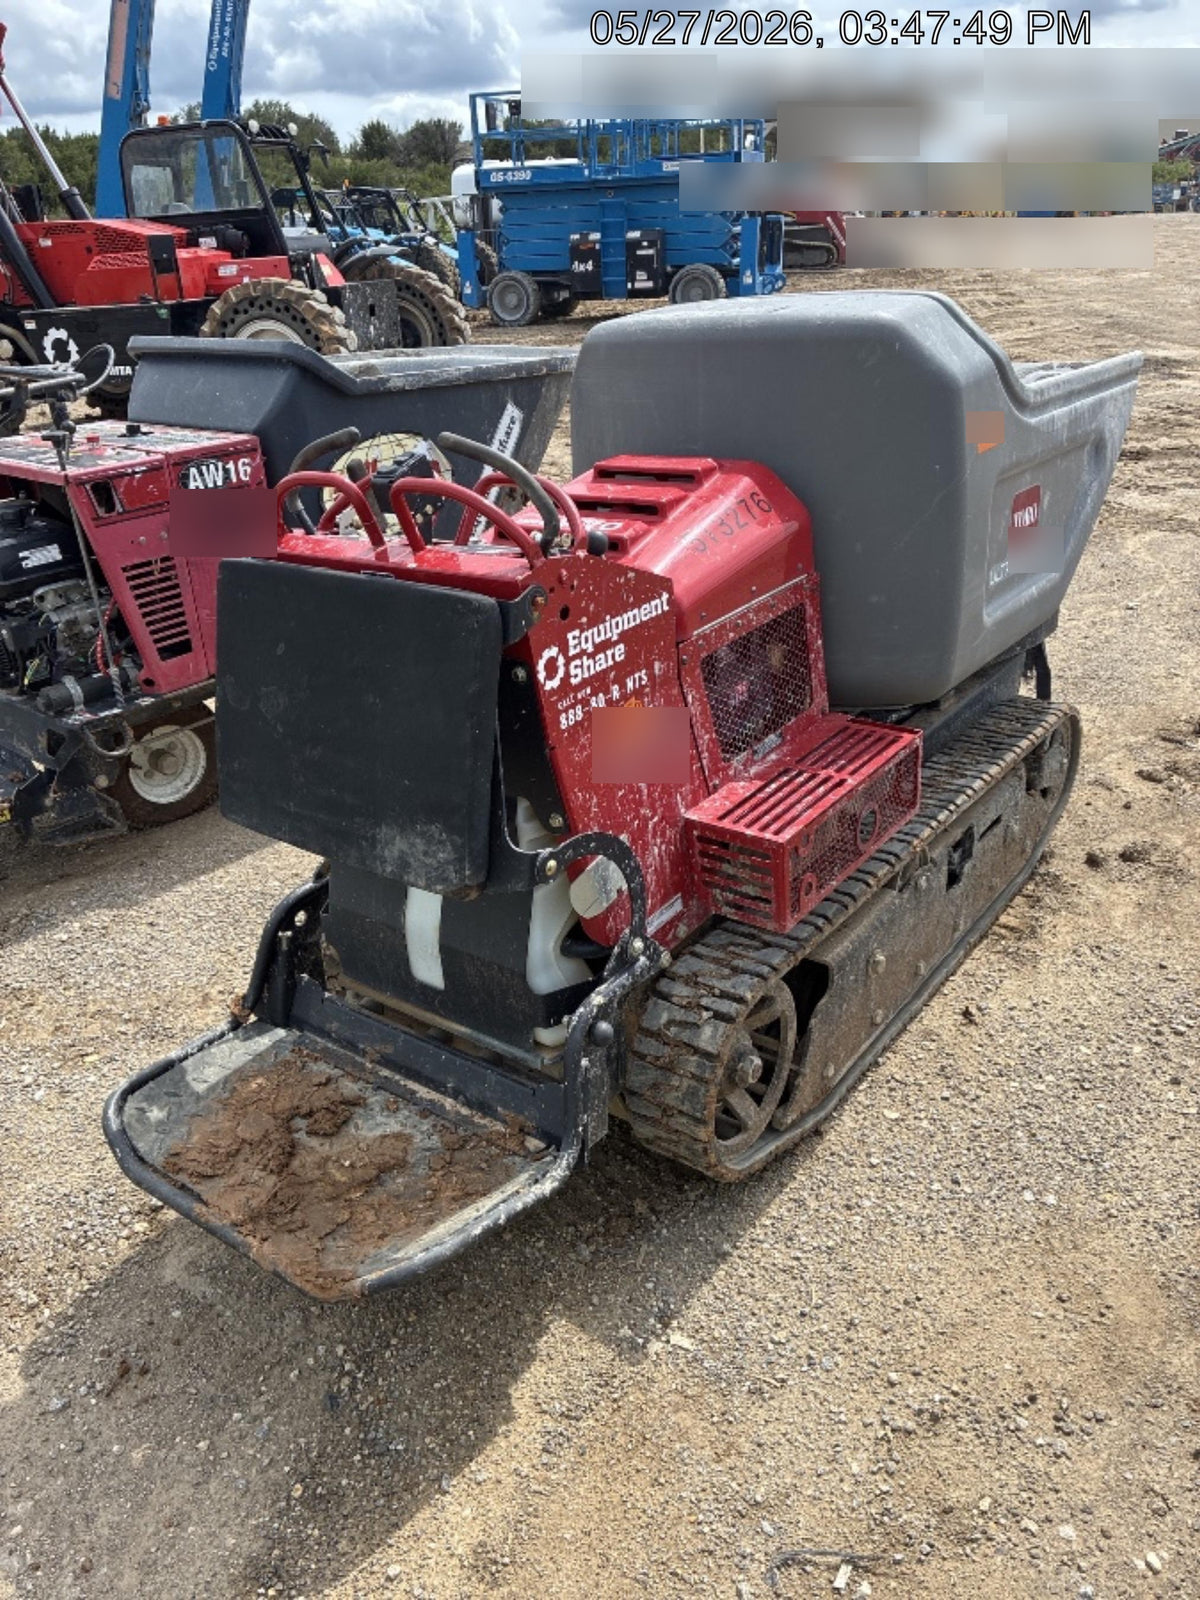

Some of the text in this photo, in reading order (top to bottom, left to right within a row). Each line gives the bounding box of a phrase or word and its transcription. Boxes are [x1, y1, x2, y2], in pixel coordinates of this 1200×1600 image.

[187, 458, 252, 490] AW16
[566, 591, 670, 657] Equipment
[569, 643, 626, 686] Share
